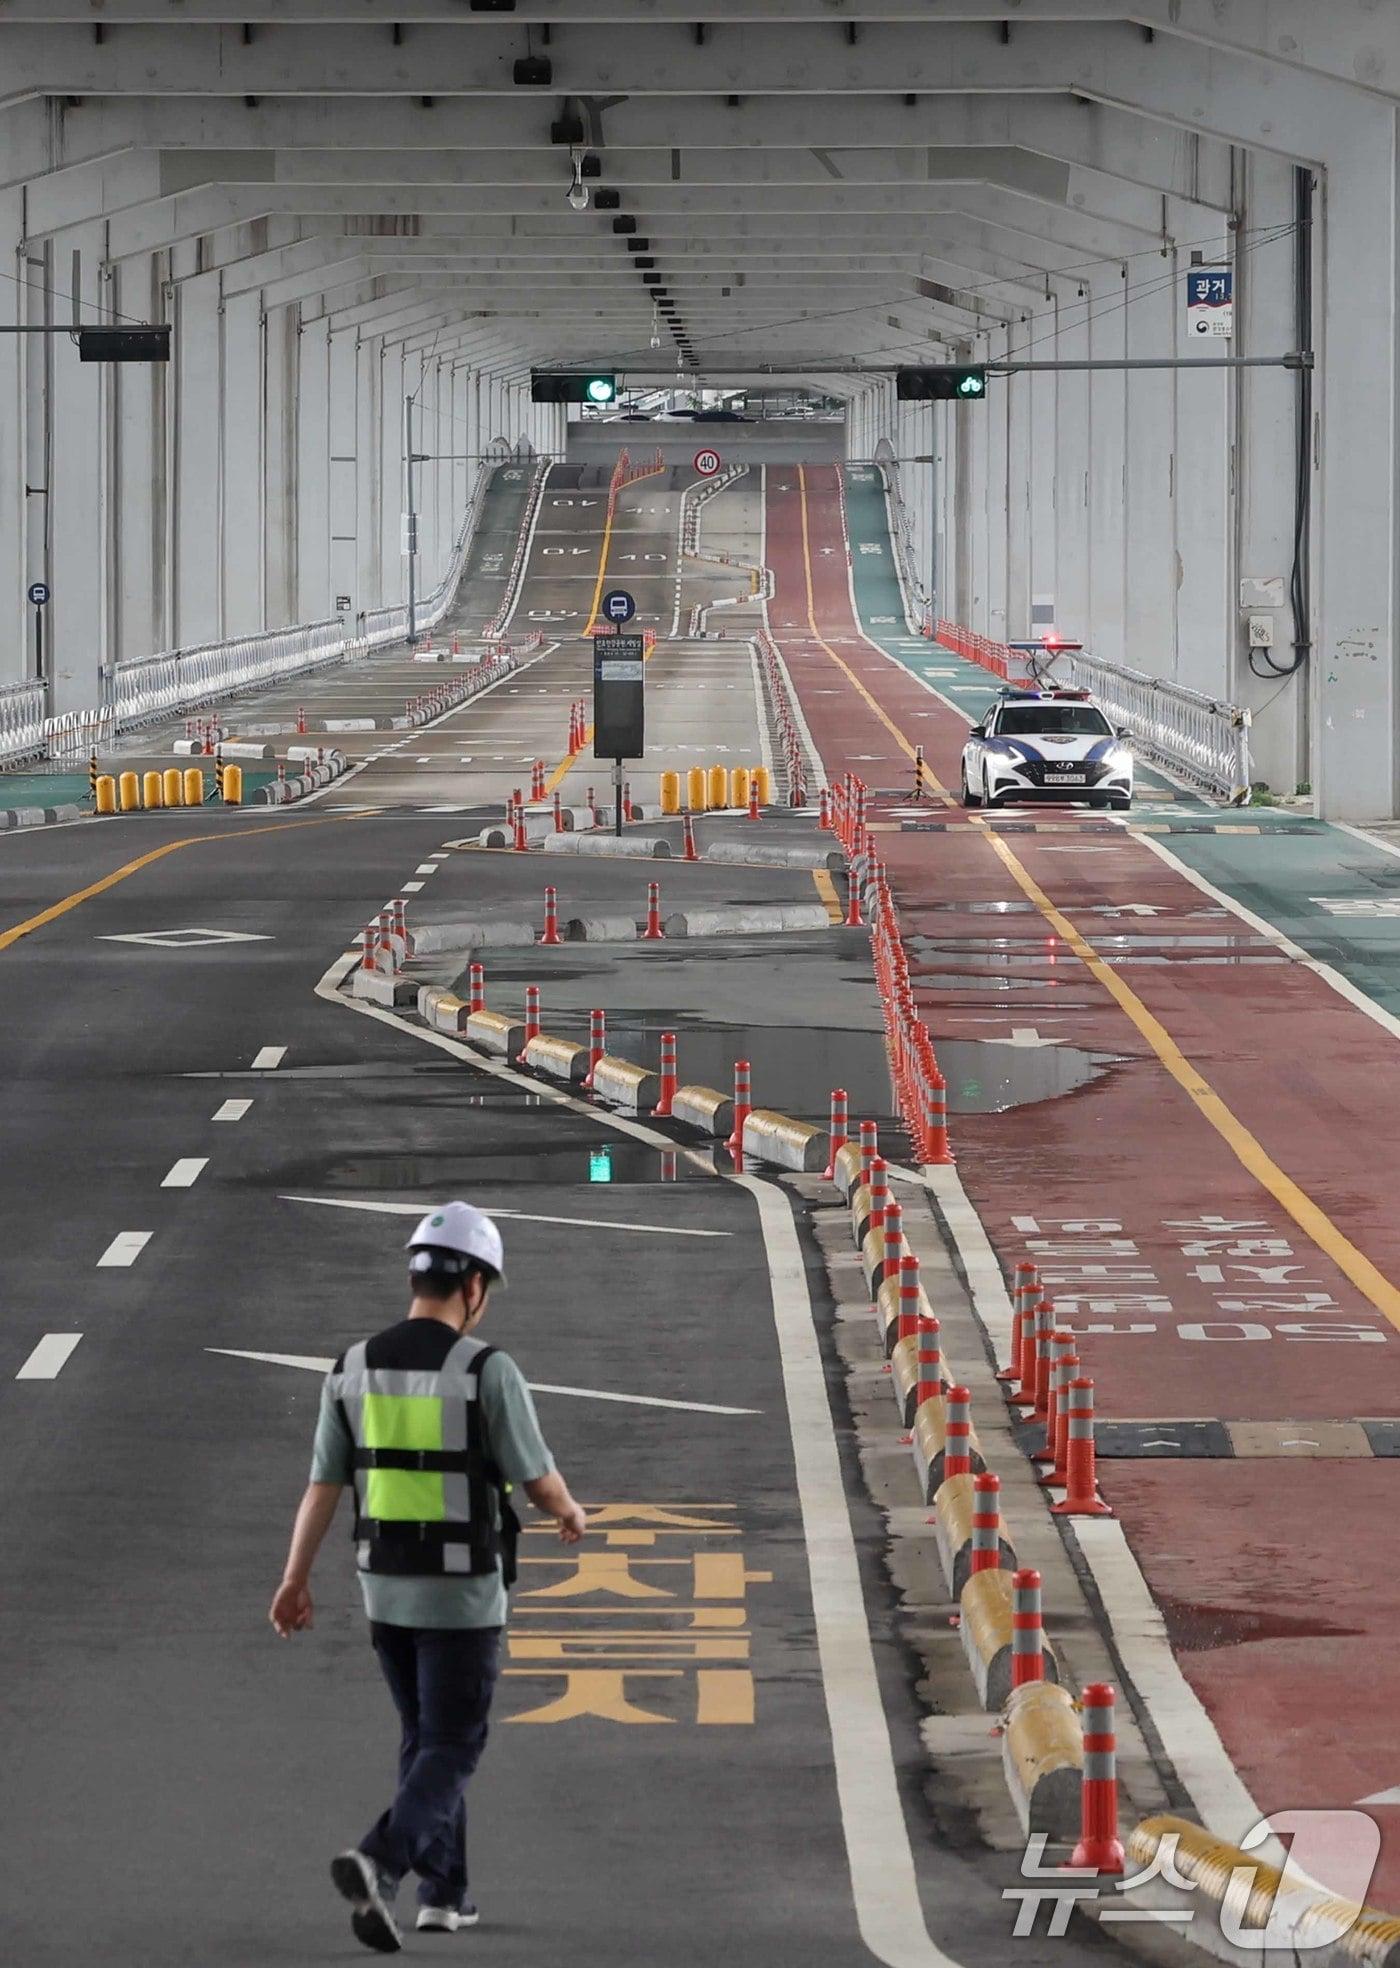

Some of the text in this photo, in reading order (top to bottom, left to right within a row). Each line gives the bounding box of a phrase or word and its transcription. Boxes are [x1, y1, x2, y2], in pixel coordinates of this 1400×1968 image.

[1196, 278, 1225, 294] 과거
[700, 455, 715, 470] 40
[1010, 1215, 1276, 1233] 주의
[1025, 1238, 1296, 1258] 없음
[1052, 1292, 1344, 1313] 전방
